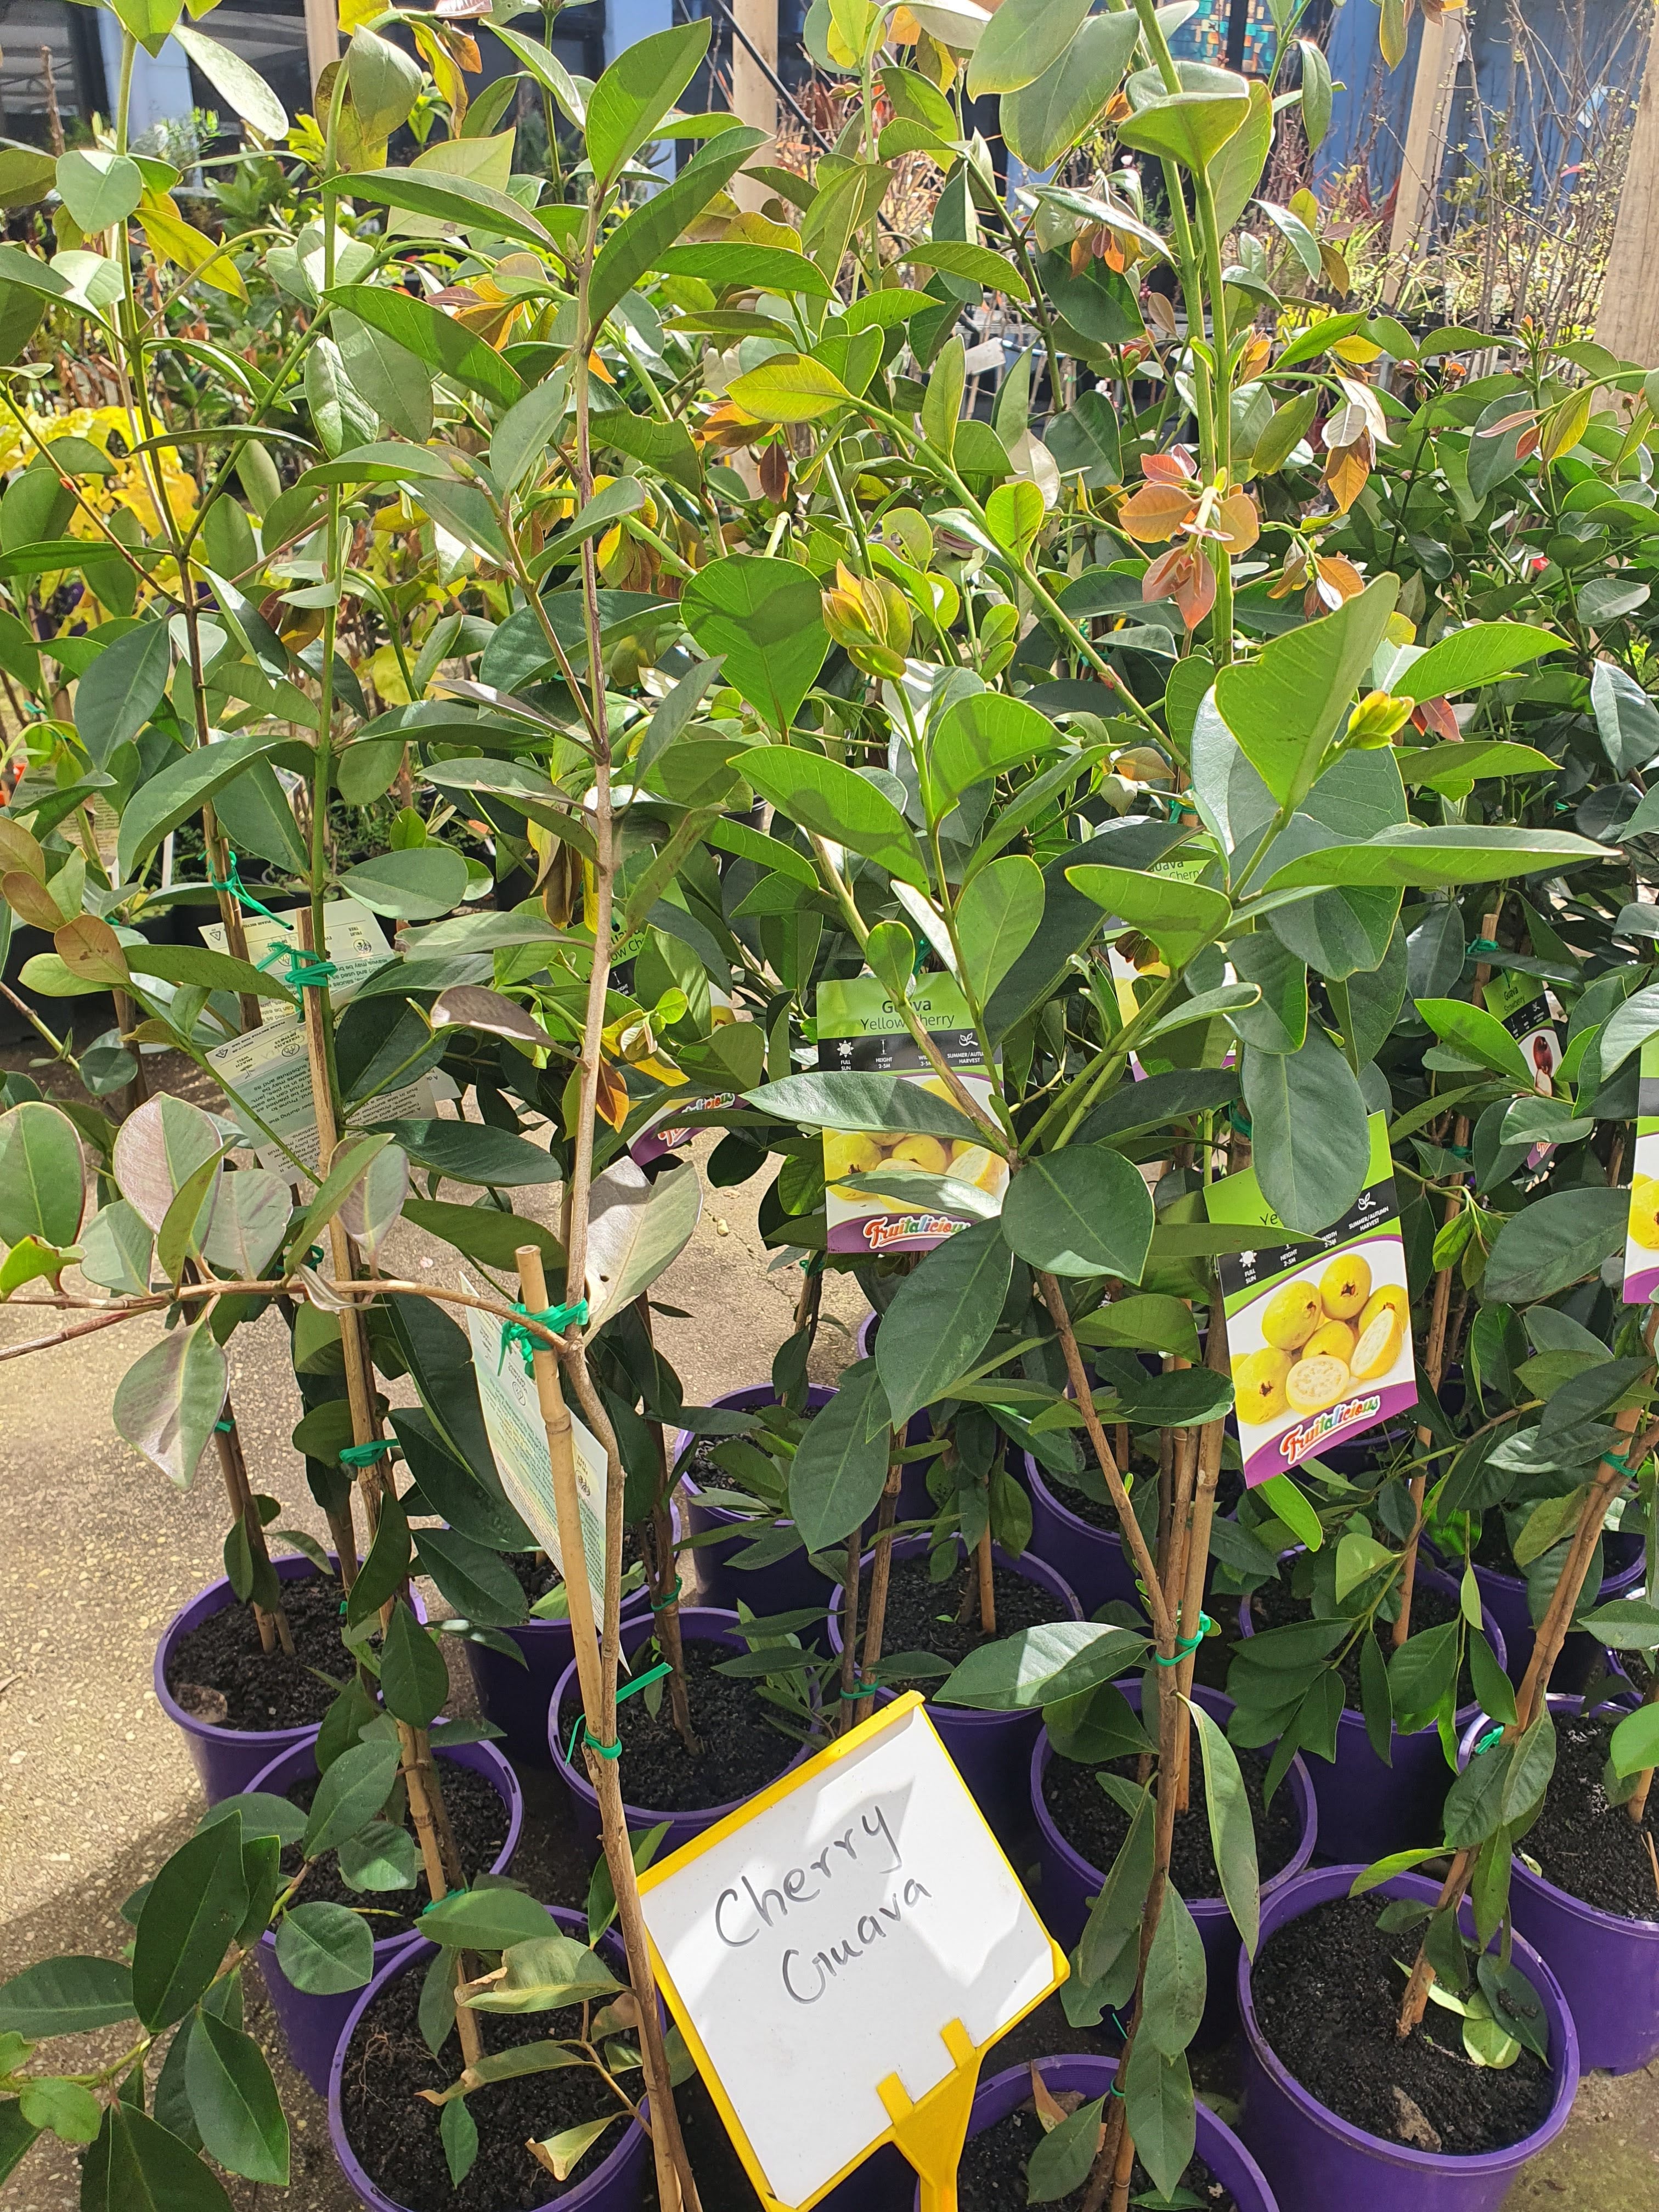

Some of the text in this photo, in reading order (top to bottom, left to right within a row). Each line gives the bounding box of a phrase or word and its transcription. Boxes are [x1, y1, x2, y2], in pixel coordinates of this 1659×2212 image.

[354, 961, 367, 969] may
[332, 978, 353, 988] sauces
[882, 1000, 931, 1014] Gva
[860, 1014, 955, 1030] Yellow herry
[273, 1034, 300, 1049] TOLERATES
[274, 1032, 296, 1045] DRYNESS
[235, 1055, 249, 1063] WELL
[235, 1057, 253, 1068] MULCH
[276, 1063, 307, 1081] substitute
[286, 1070, 306, 1082] seeds
[262, 1078, 275, 1087] and
[271, 1079, 285, 1088] may
[289, 1082, 304, 1092] Fruit
[276, 1090, 288, 1098] can
[250, 1101, 266, 1110] eate
[264, 1094, 289, 1109] planted
[278, 1097, 298, 1109] Prune
[361, 1101, 386, 1114] summer
[279, 1106, 301, 1119] during
[362, 1103, 391, 1119] Produces
[268, 1116, 279, 1125] the
[294, 1139, 308, 1149] juicy
[278, 1159, 292, 1167] reen
[1348, 1205, 1389, 1230] SUMMER/AUTUMN
[1359, 1217, 1380, 1232] HARVEST
[1280, 1248, 1297, 1262] HEIGHT
[1283, 1256, 1296, 1267] 2-5M
[1244, 1268, 1256, 1278] FULL
[1245, 1275, 1256, 1284] SUN
[1281, 1396, 1379, 1463] Fruitalicious
[714, 1805, 903, 1947] Cherry
